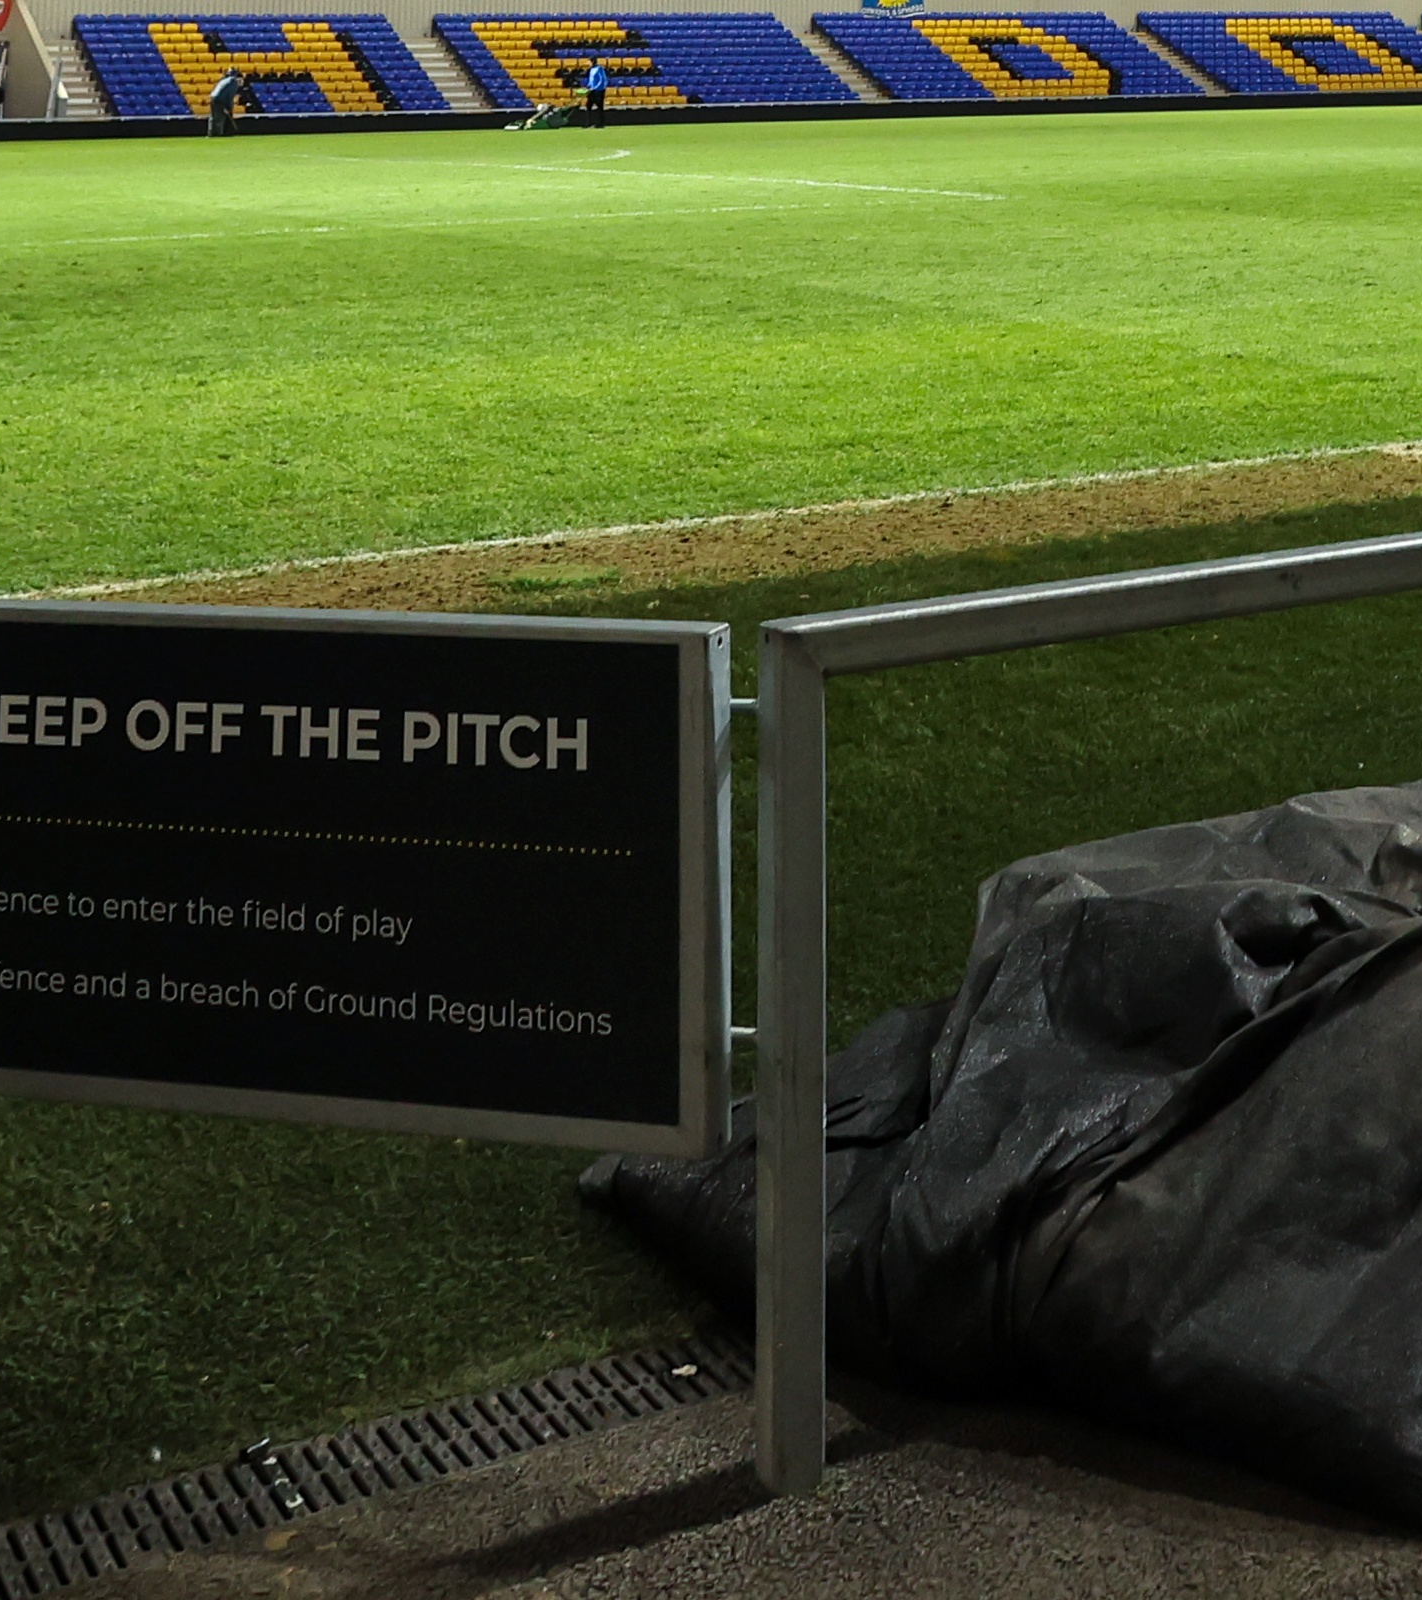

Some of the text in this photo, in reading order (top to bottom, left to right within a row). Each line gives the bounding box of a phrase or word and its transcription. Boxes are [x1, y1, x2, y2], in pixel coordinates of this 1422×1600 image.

[125, 699, 245, 754] OFF
[260, 704, 381, 761] THE
[403, 710, 588, 771] PITCH
[67, 891, 95, 918] to
[103, 891, 178, 923] enter
[185, 897, 234, 927] the
[242, 899, 306, 932] field
[315, 906, 344, 934] of
[352, 907, 413, 945] play
[73, 971, 126, 999] and
[135, 980, 151, 1000] a
[161, 973, 259, 1008] breach
[268, 982, 298, 1011] of
[304, 985, 417, 1021] Ground
[427, 994, 613, 1036] Regulations
